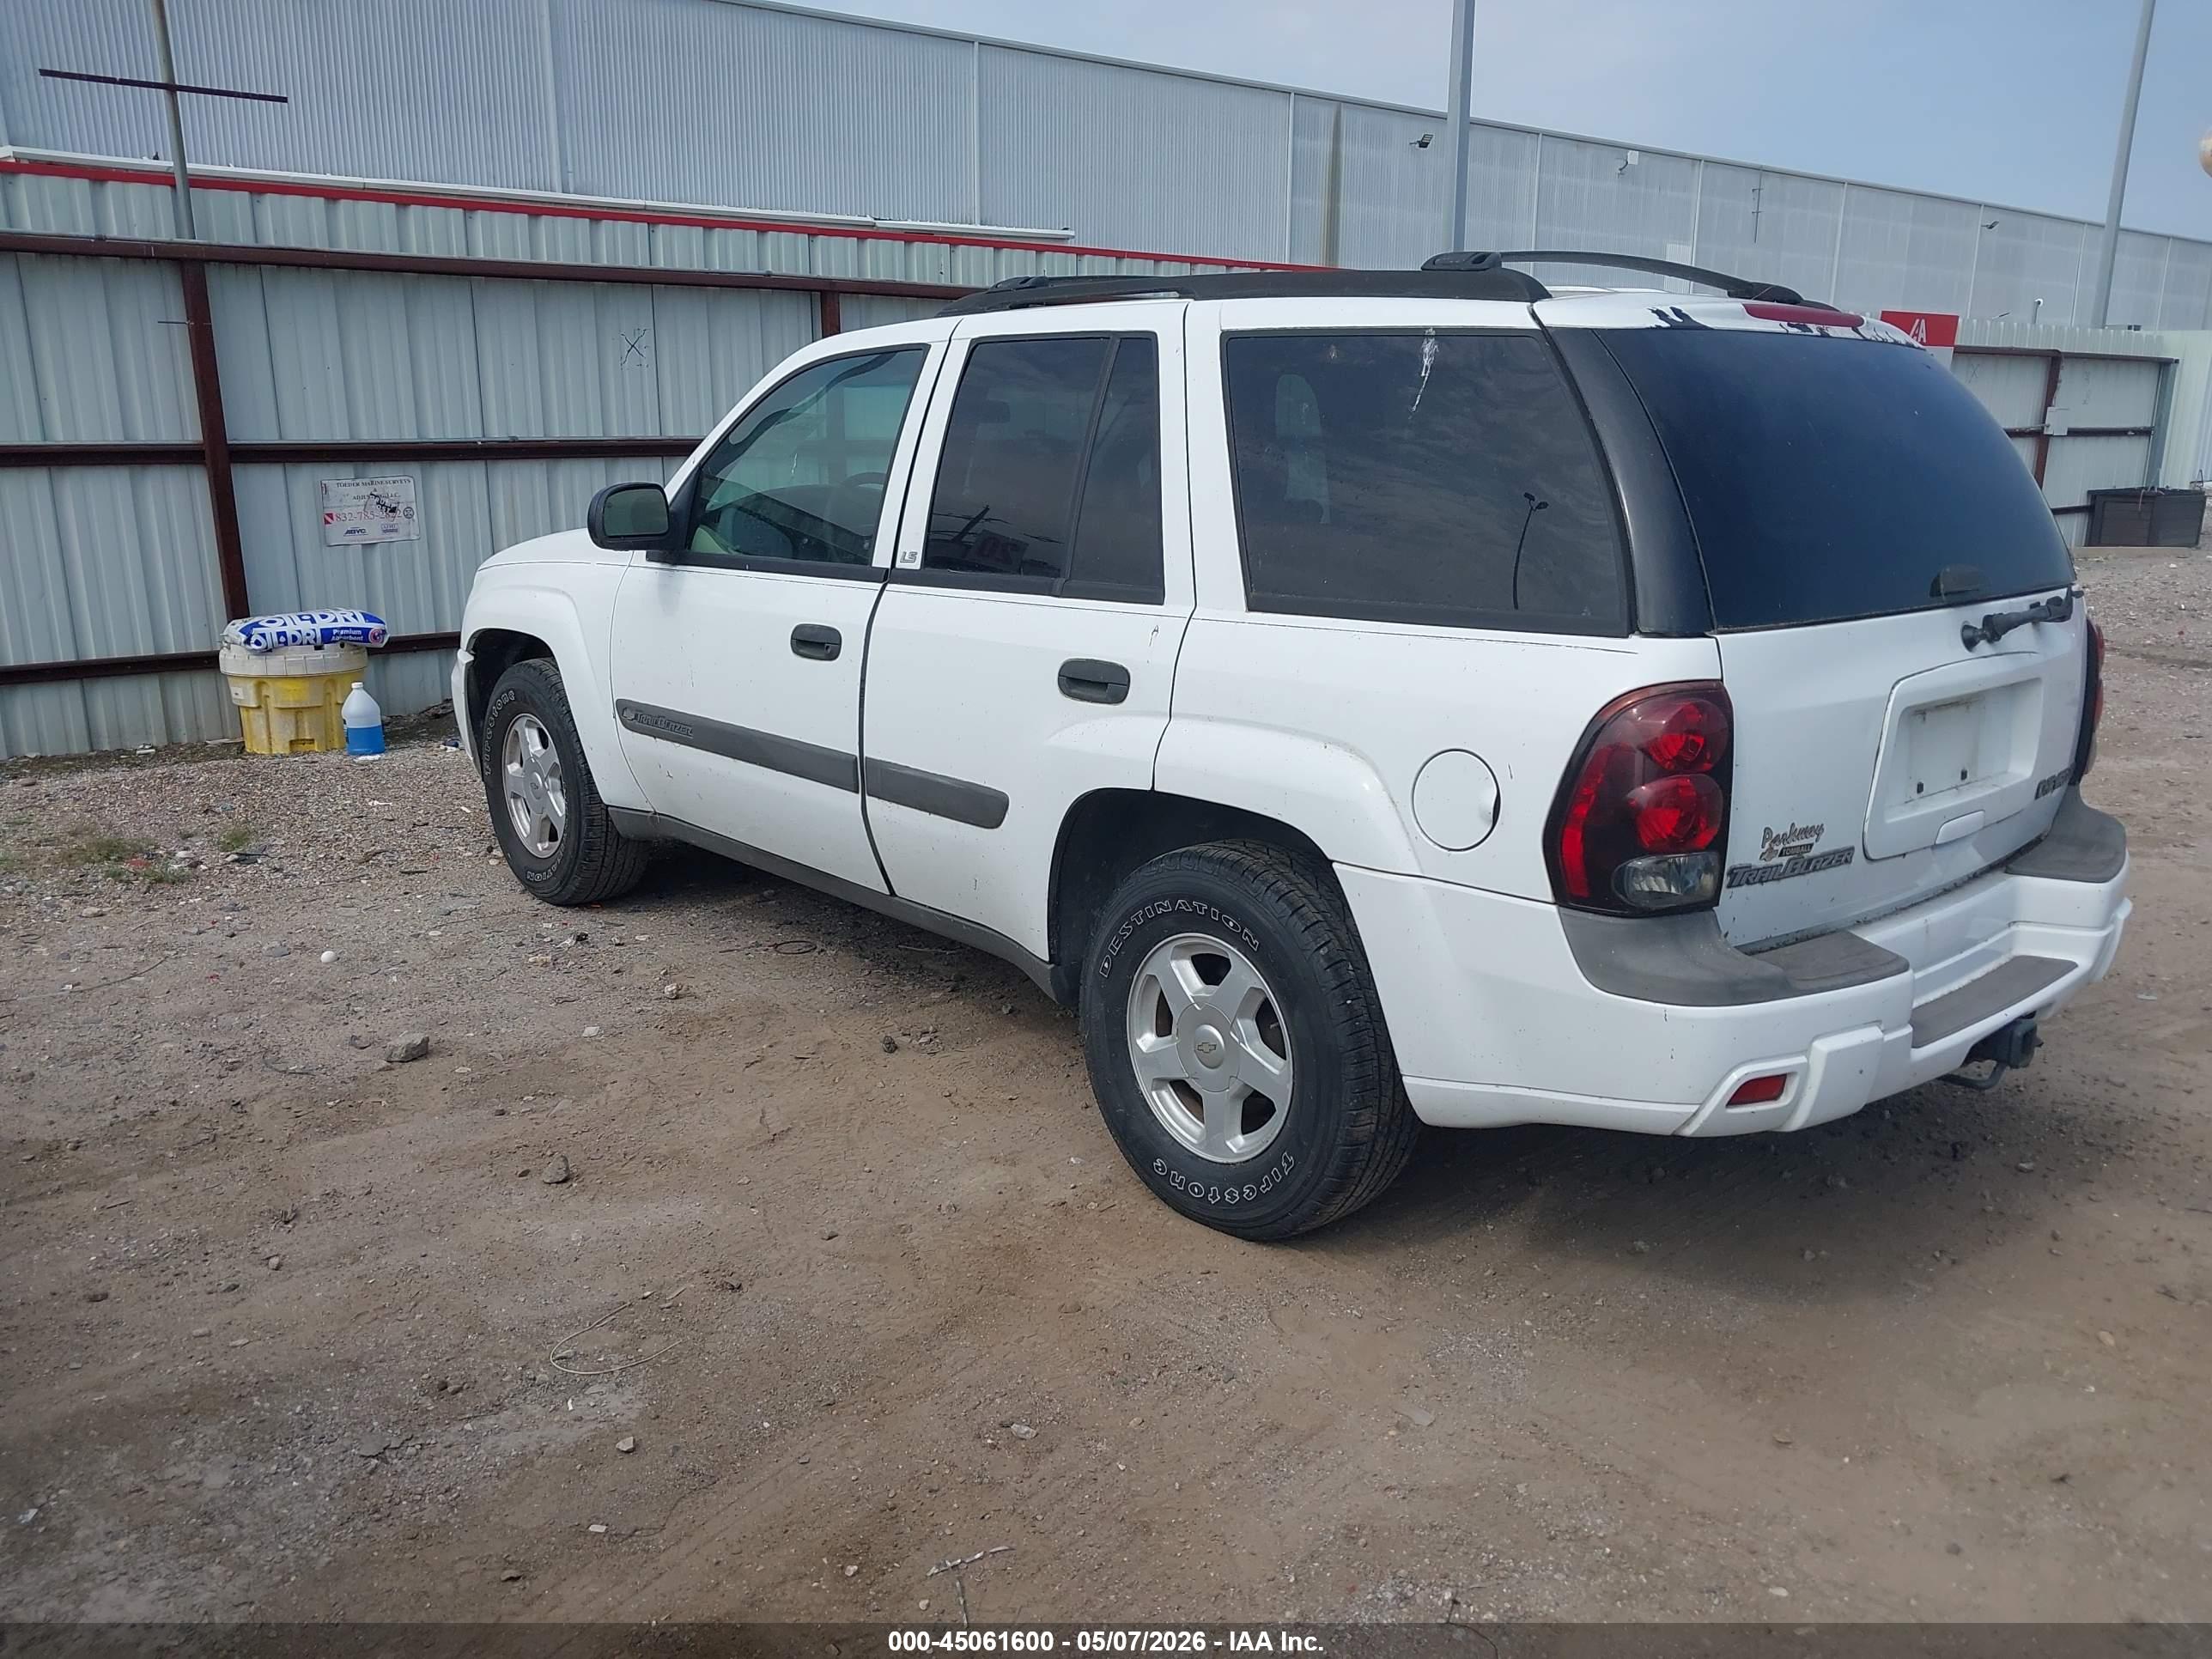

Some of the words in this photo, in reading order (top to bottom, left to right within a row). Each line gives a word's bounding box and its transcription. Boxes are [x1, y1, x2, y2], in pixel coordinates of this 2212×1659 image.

[1761, 822, 1825, 848] Parkway
[1782, 844, 1812, 856] TOMBALL
[1098, 899, 1259, 978] DESTINATION
